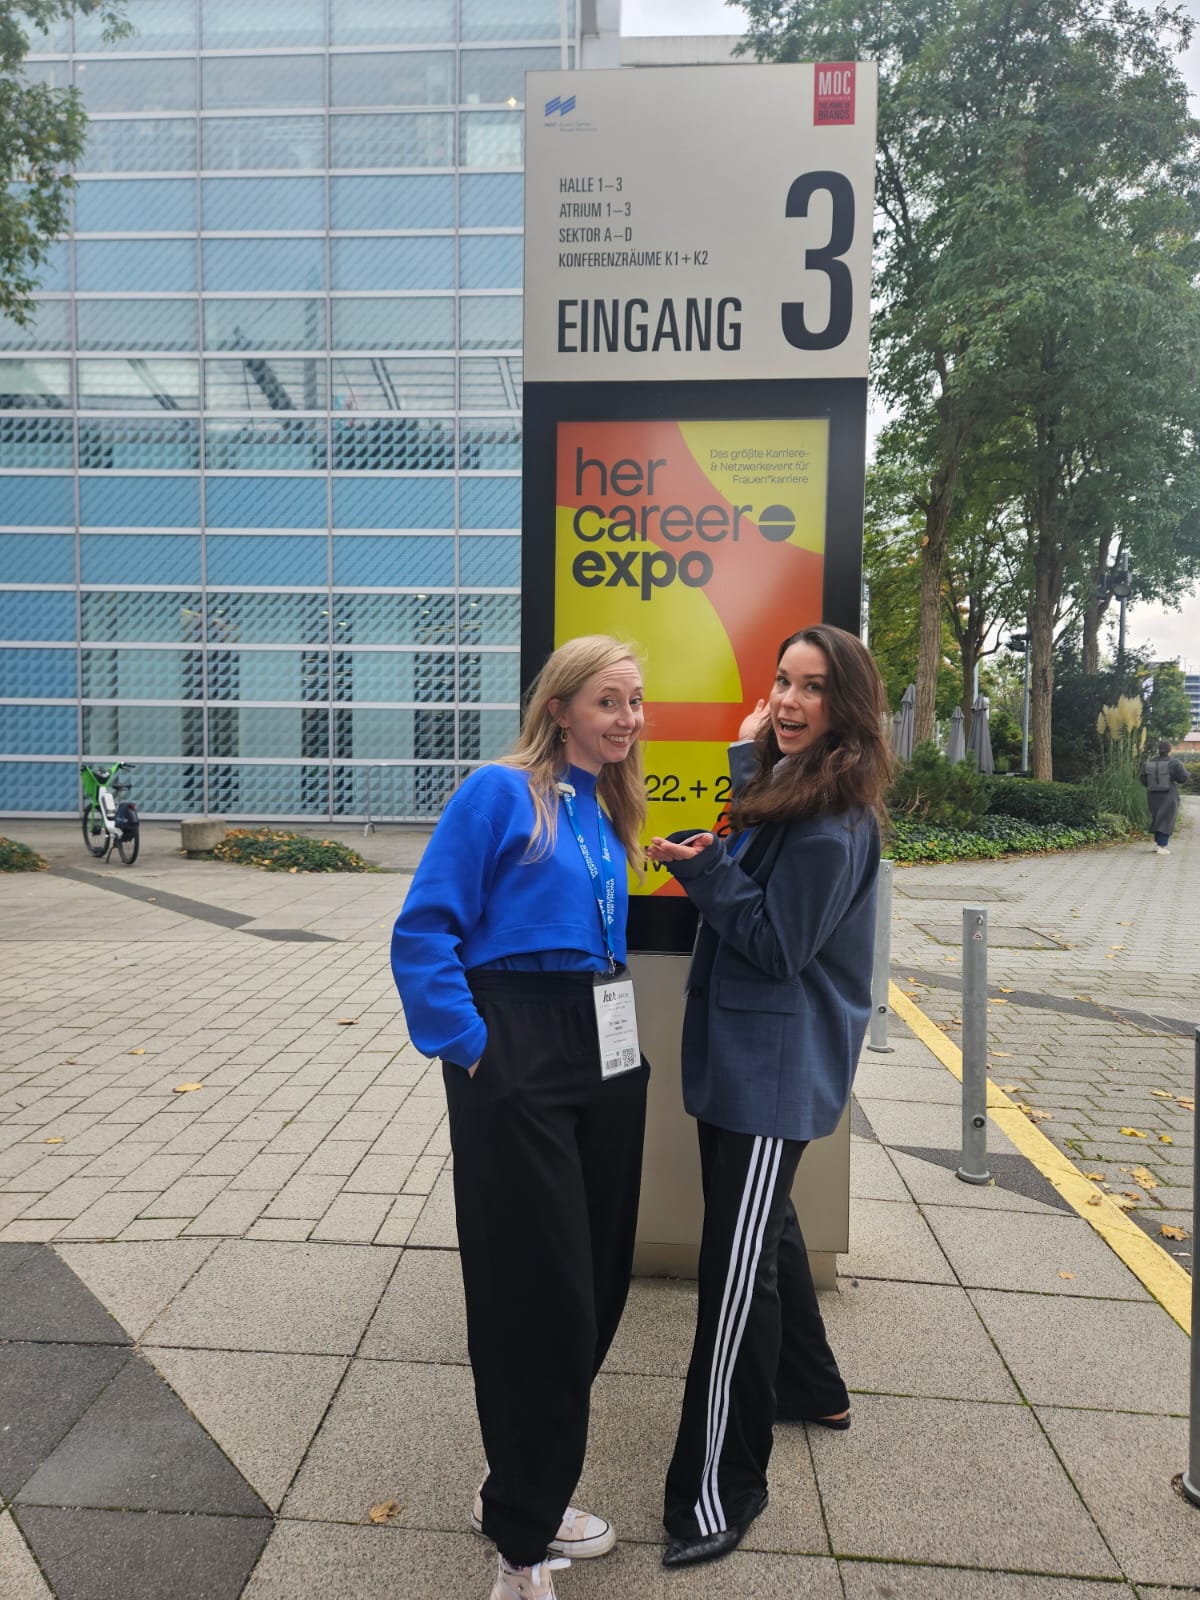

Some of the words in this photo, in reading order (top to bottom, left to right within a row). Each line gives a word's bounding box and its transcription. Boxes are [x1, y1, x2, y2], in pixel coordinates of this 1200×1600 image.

[819, 70, 851, 96] MOC
[818, 109, 850, 120] BRANDS
[559, 177, 594, 193] HALLE
[559, 202, 602, 218] ATRIUM
[559, 227, 601, 243] SEKTOR
[559, 249, 662, 268] KONFERENZRÄUME
[781, 170, 856, 351] 3
[557, 296, 742, 353] EINGANG
[710, 449, 728, 459] Das
[730, 448, 763, 460] größte
[766, 448, 808, 458] Karriere-
[575, 447, 667, 496] her
[720, 461, 793, 471] Netzwerkevent
[795, 461, 808, 471] für
[573, 504, 753, 542] career
[572, 550, 714, 601] expo
